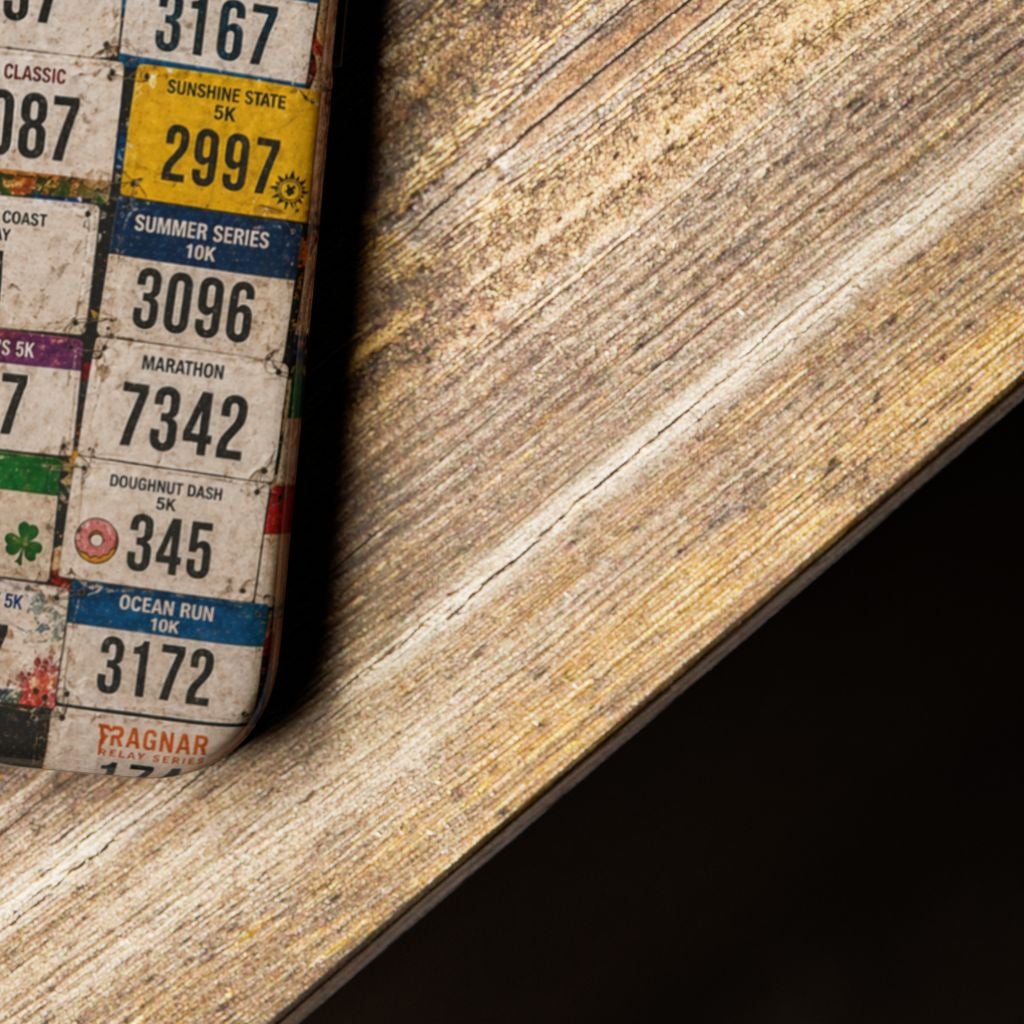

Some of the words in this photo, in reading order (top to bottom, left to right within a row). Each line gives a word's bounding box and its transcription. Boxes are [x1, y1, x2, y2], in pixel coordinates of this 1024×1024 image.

[4, 63, 67, 84] CLASSIC
[167, 80, 241, 103] SUNSHINE
[244, 90, 287, 110] STATE
[214, 105, 236, 122] 5K
[161, 124, 281, 194] 2997
[2, 210, 48, 227] COAST
[134, 214, 207, 241] SUMMER
[212, 225, 270, 249] SERIES
[185, 244, 216, 262] 10K
[133, 268, 255, 343] 3096
[15, 341, 35, 359] 5K
[141, 355, 225, 380] MARATHON
[119, 381, 249, 461] 7342
[109, 474, 184, 495] DOUGHNUT
[187, 483, 223, 501] DASH
[156, 497, 176, 512] 5K
[126, 513, 214, 579] 345
[4, 593, 24, 610] 5K
[119, 595, 175, 617] OCEAN
[180, 603, 215, 622] RUN
[150, 618, 180, 634] 10K
[97, 636, 215, 707] 3172
[98, 723, 208, 755] RAGNAR
[98, 749, 145, 760] RELAY
[152, 755, 205, 765] SERIES
